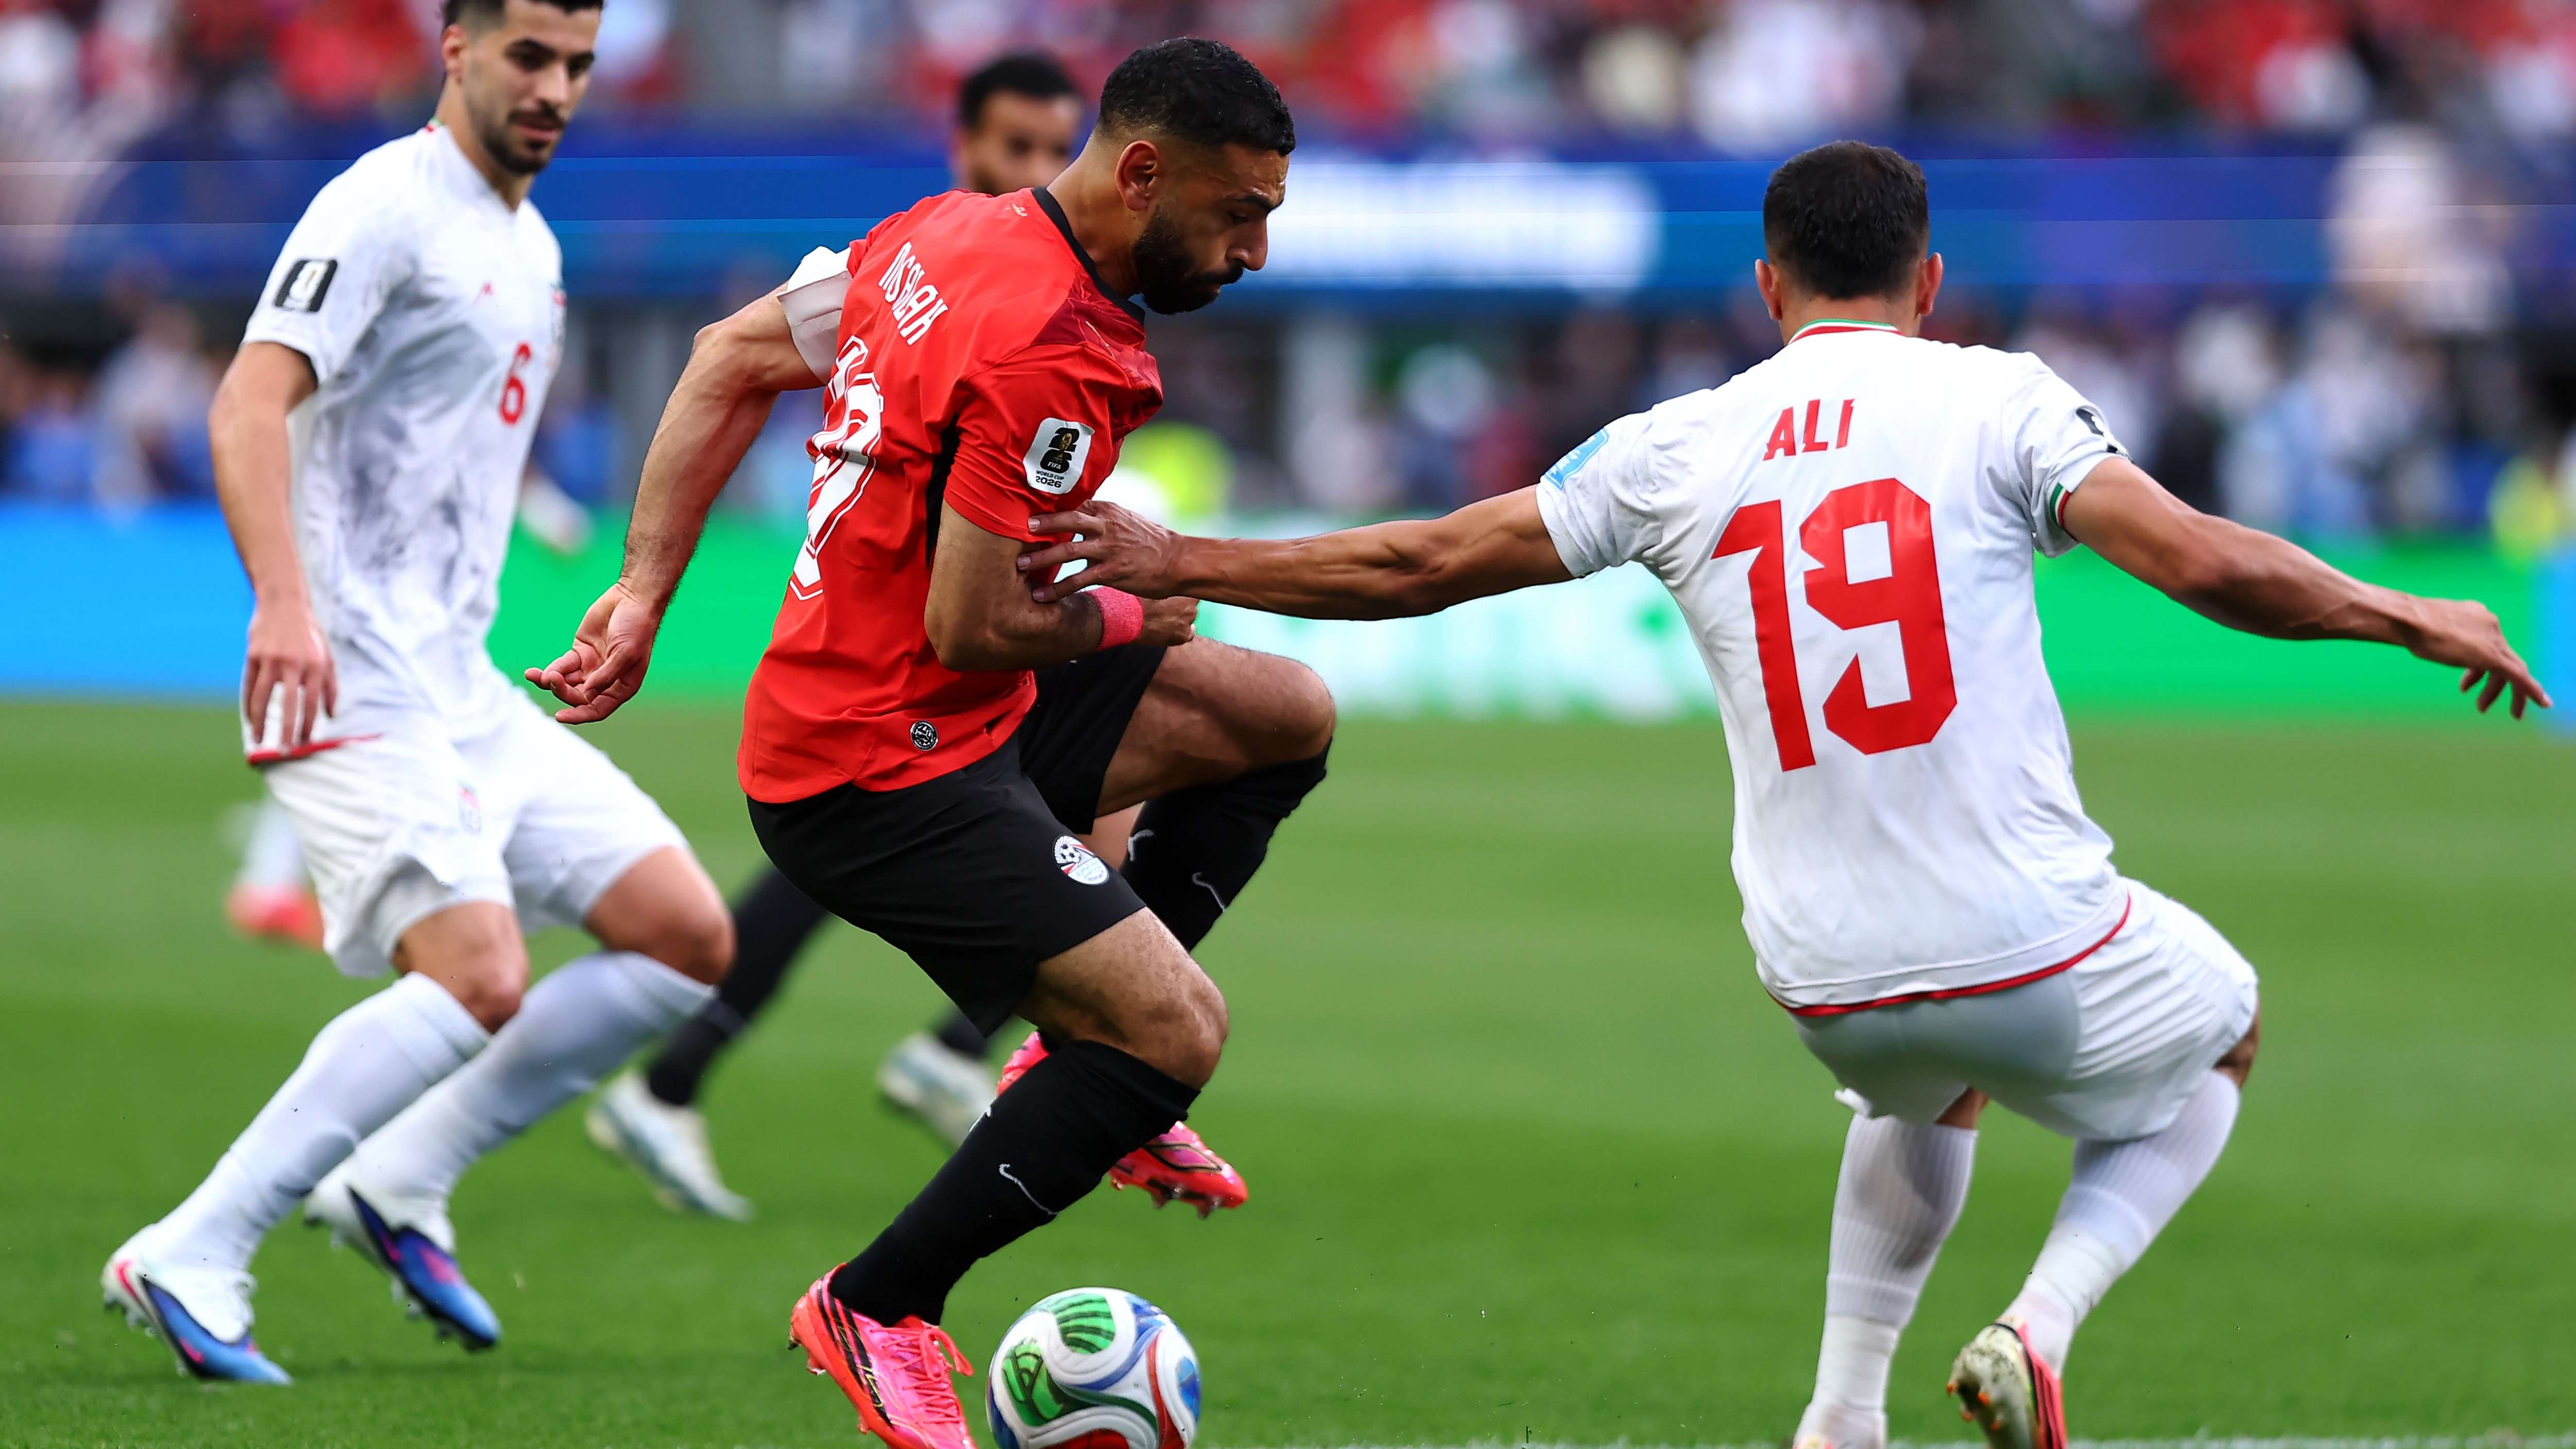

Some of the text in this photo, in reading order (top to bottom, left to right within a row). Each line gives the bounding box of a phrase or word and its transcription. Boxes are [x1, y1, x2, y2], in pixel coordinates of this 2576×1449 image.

[499, 342, 532, 425] 6
[1763, 398, 1855, 461] ALI
[1036, 476, 1062, 488] 2026
[1710, 478, 1958, 772] 19
